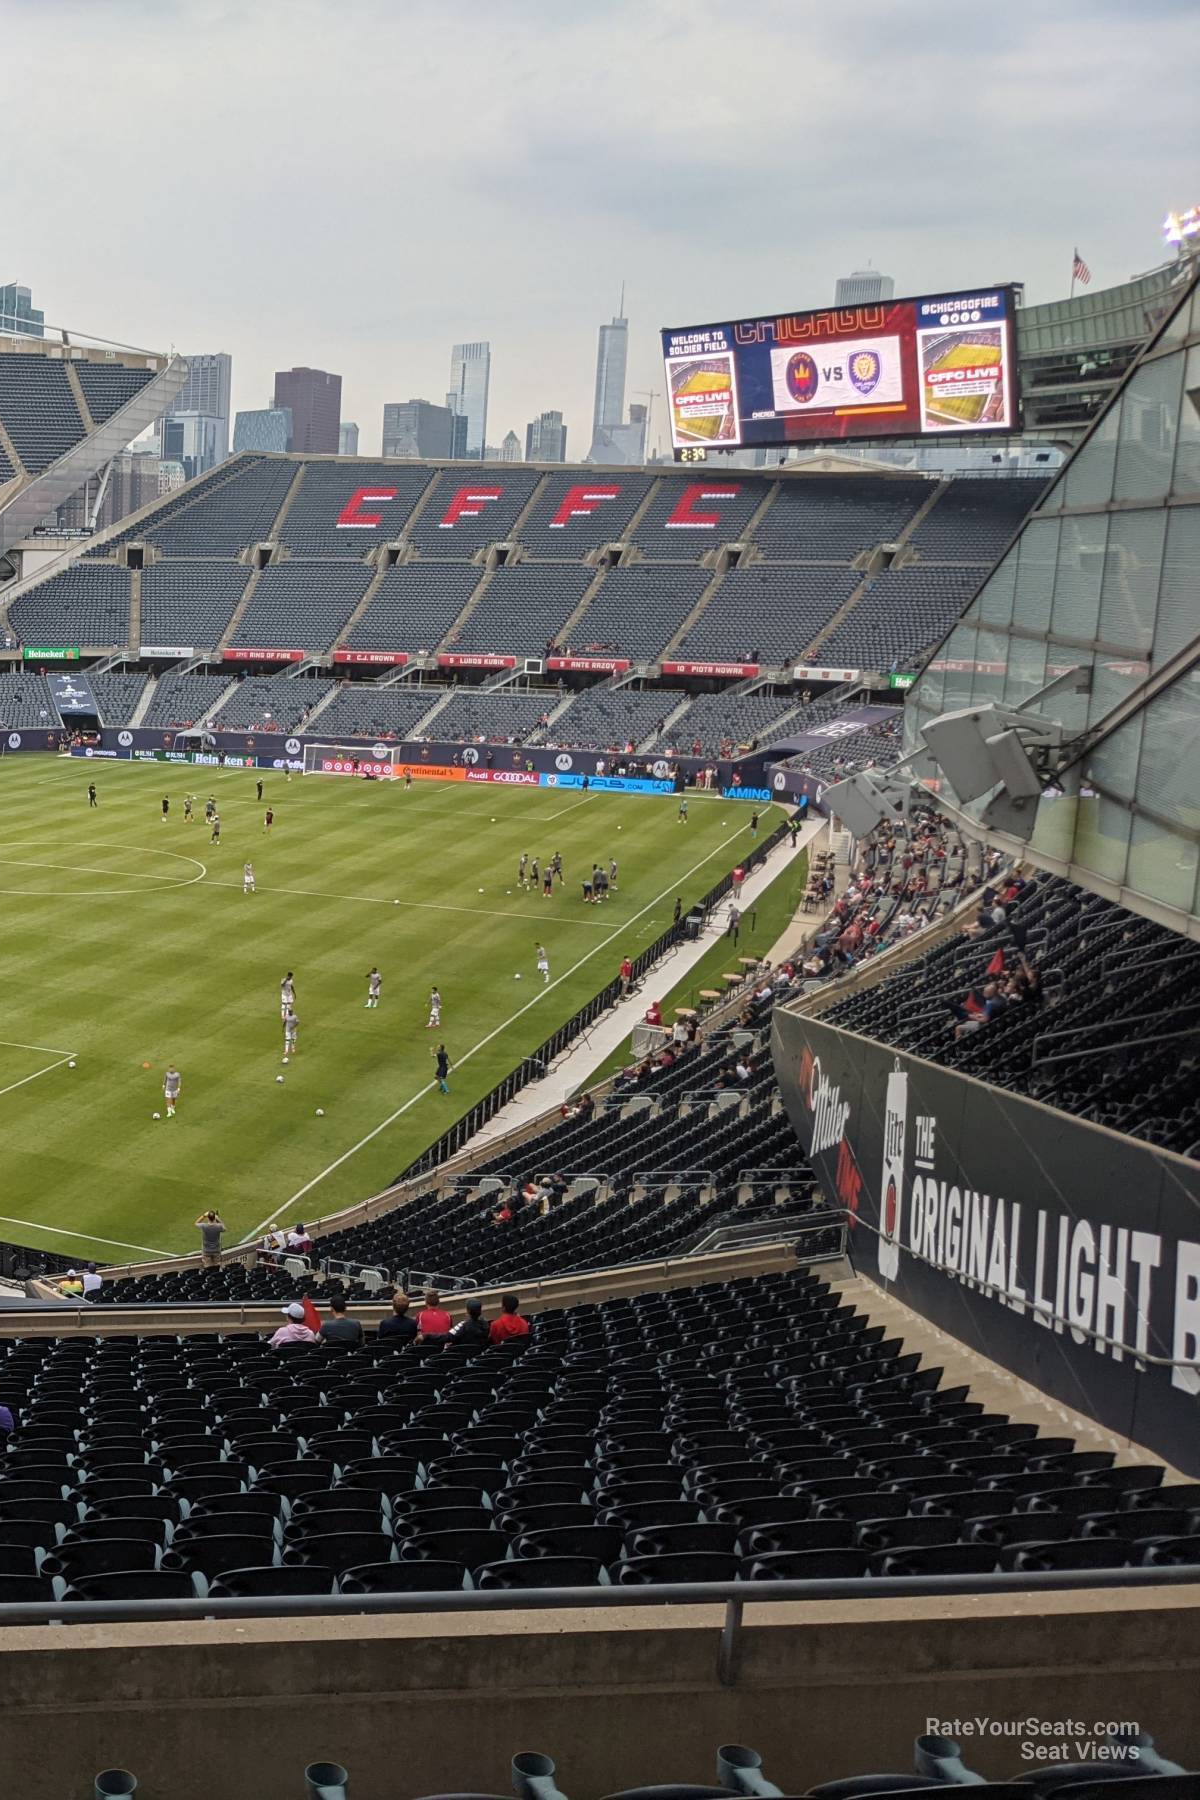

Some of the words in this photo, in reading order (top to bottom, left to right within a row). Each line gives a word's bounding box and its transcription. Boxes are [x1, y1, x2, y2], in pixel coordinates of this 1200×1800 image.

[921, 296, 999, 315] @CHICAGOFIRE
[671, 333, 711, 346] WELCOME
[712, 331, 723, 342] TO
[669, 343, 702, 356] SOLDIER
[704, 341, 727, 352] FIELD
[822, 366, 843, 382] VS
[927, 371, 965, 383] CFFC
[966, 367, 999, 379] LIVE
[675, 394, 705, 405] CFFC
[706, 391, 730, 402] LIVE
[681, 448, 706, 461] 2:39
[28, 650, 64, 658] Heineken
[571, 661, 589, 669] ANTE
[195, 753, 243, 766] Heinken
[403, 766, 447, 776] Cntinental
[467, 771, 488, 780] Audi
[809, 1055, 851, 1158] Miller
[915, 1116, 936, 1159] THE
[910, 1175, 1026, 1315] ORIGINAL
[1033, 1210, 1162, 1372] LIGHT
